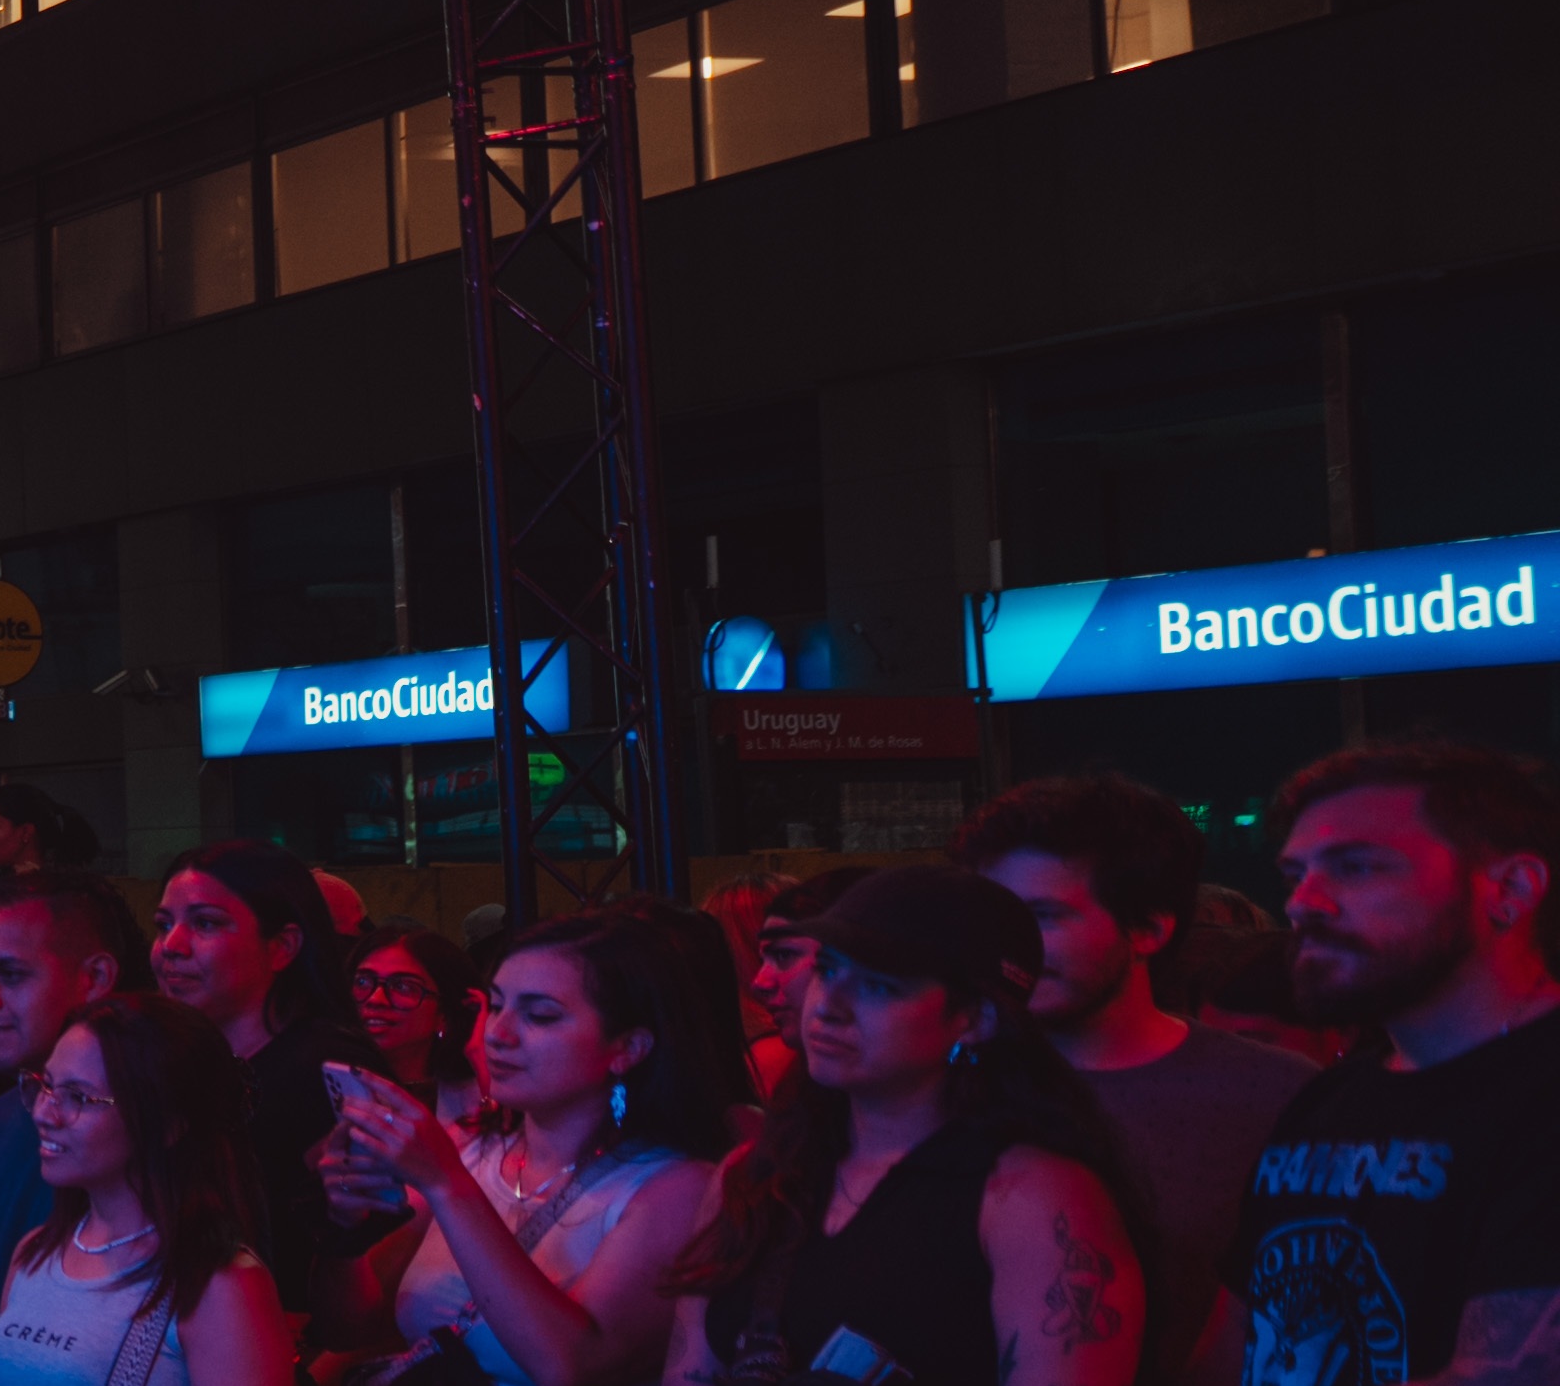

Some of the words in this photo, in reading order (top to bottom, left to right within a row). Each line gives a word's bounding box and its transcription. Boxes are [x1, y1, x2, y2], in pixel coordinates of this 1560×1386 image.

[1158, 565, 1536, 654] BancoCiudad
[304, 669, 495, 726] BancoCiudad
[742, 710, 842, 735] Uruguay
[888, 735, 922, 748] Rosas
[1254, 1137, 1454, 1201] RAMONES
